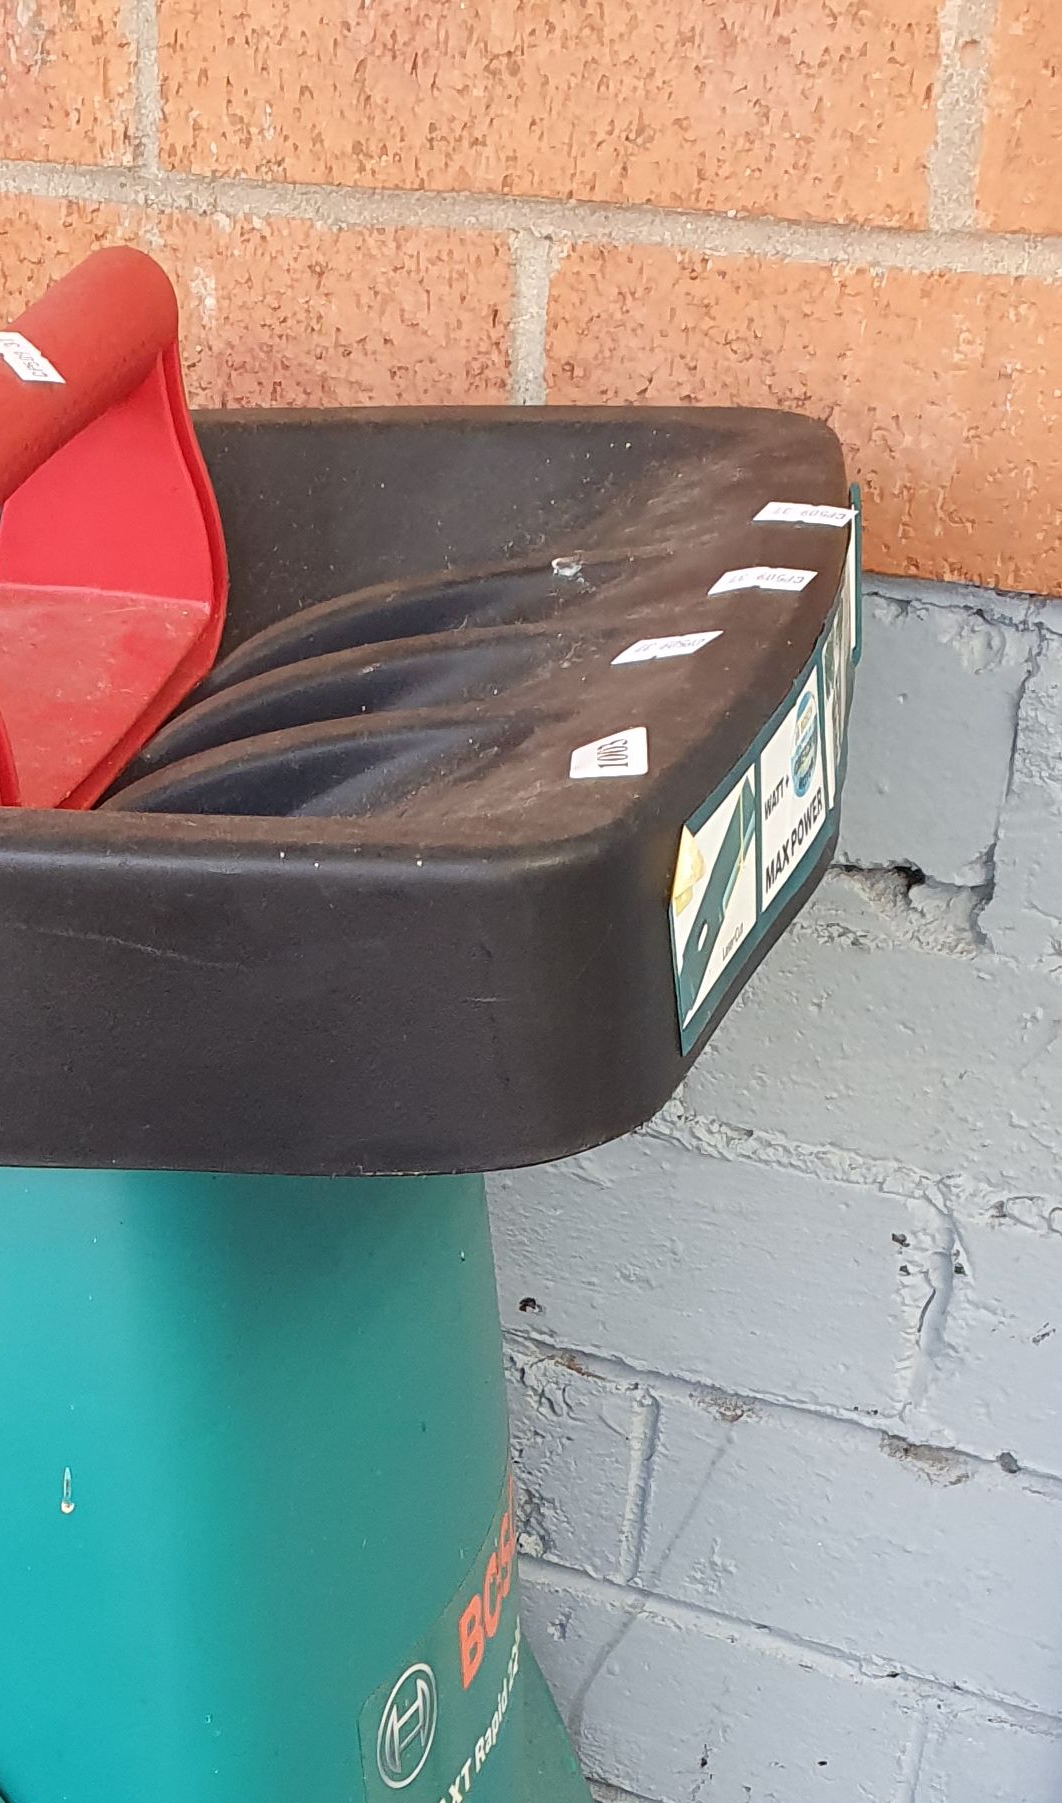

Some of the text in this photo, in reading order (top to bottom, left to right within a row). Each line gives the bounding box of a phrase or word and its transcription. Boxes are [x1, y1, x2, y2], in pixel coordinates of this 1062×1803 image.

[764, 781, 784, 821] WATT
[765, 835, 791, 894] MAX
[791, 786, 823, 859] POWER
[475, 1677, 510, 1773] Rapid
